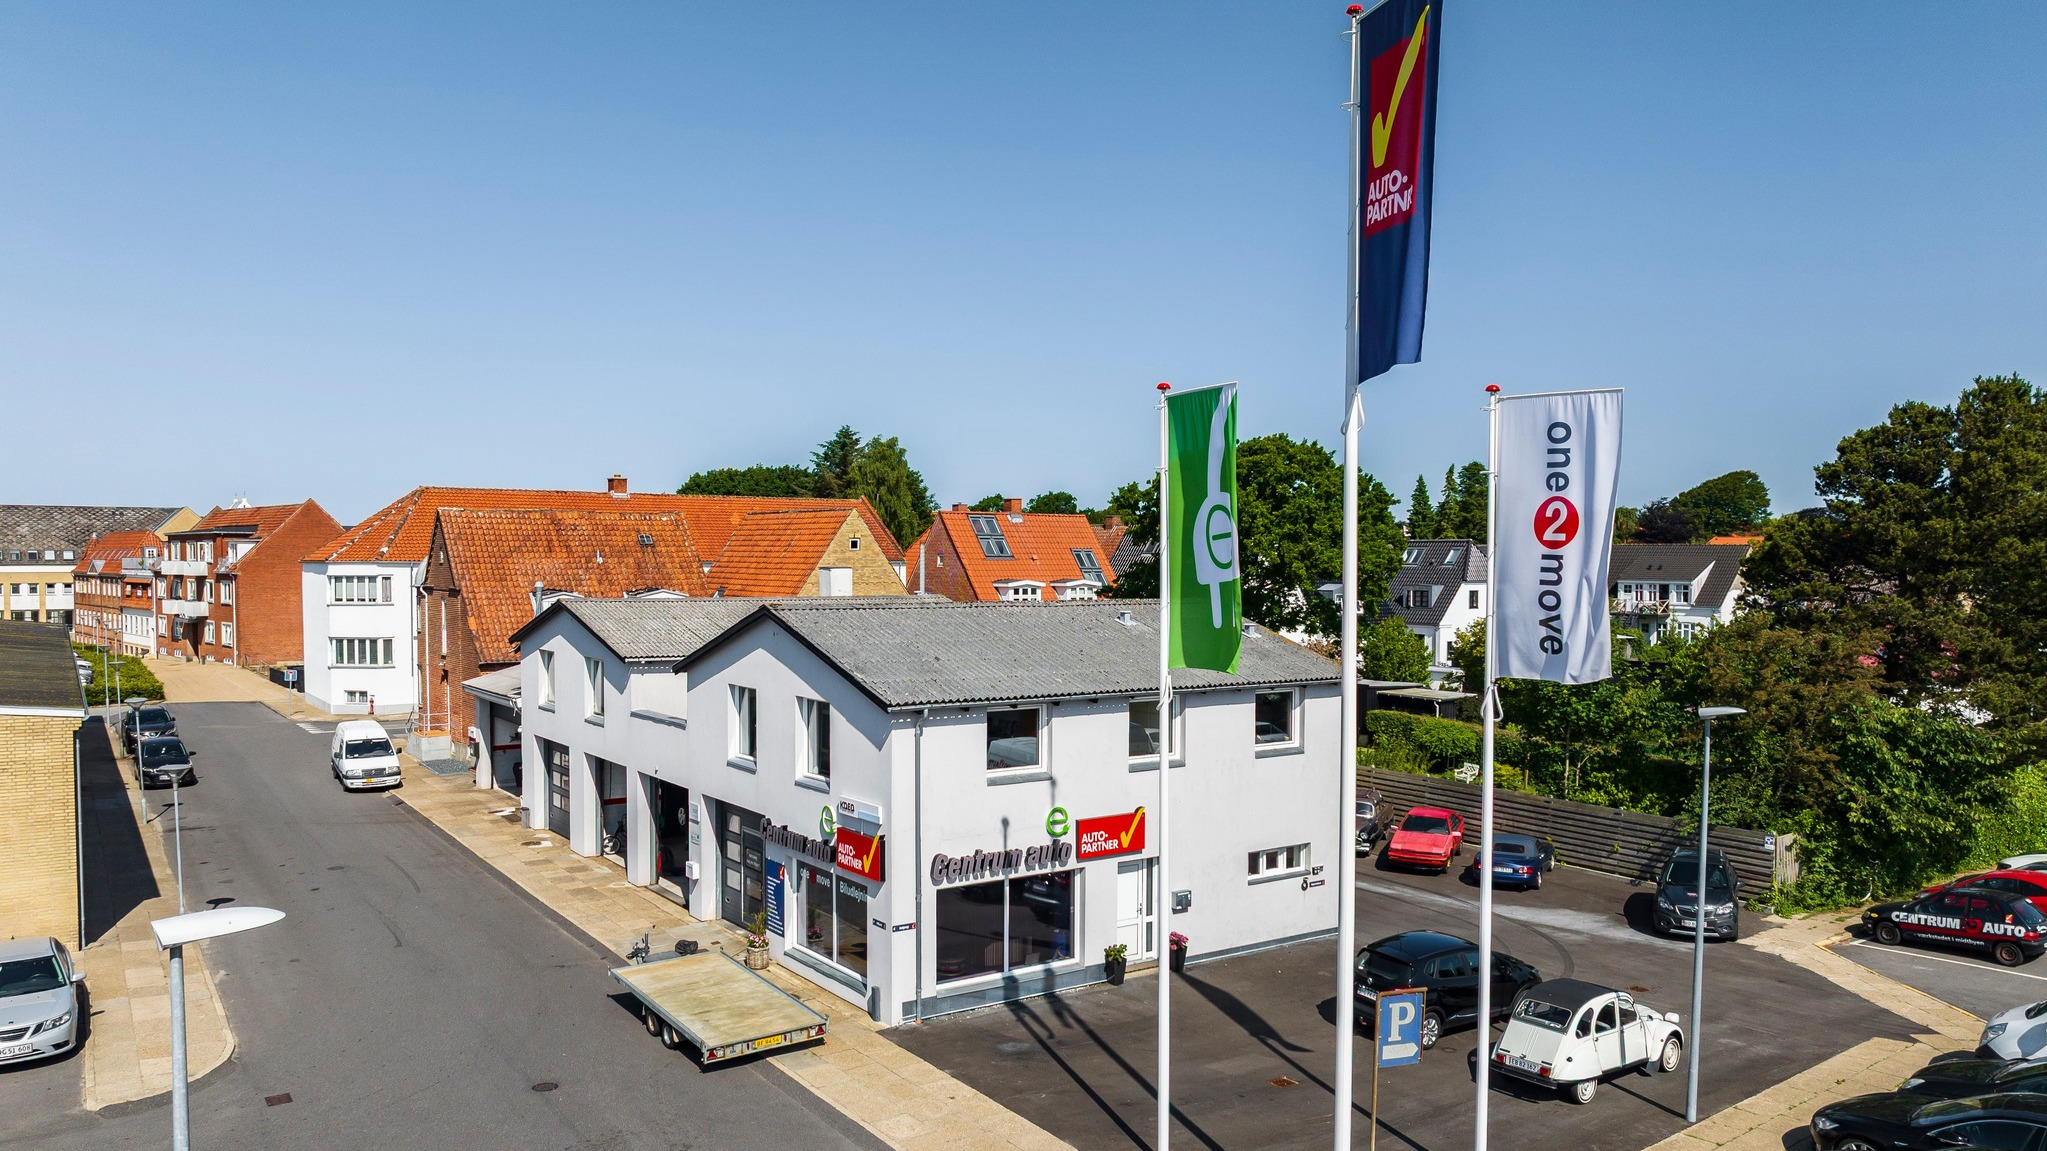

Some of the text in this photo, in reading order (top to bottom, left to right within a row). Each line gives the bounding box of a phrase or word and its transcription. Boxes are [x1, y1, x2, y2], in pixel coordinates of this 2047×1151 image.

[760, 817, 833, 863] Centrum auto
[1081, 839, 1119, 854] PARTNER
[837, 852, 863, 871] PARTNER
[931, 839, 1073, 882] Centrum auto
[1891, 911, 2027, 938] CENTRUM AUTO
[1388, 1001, 1416, 1042] P
